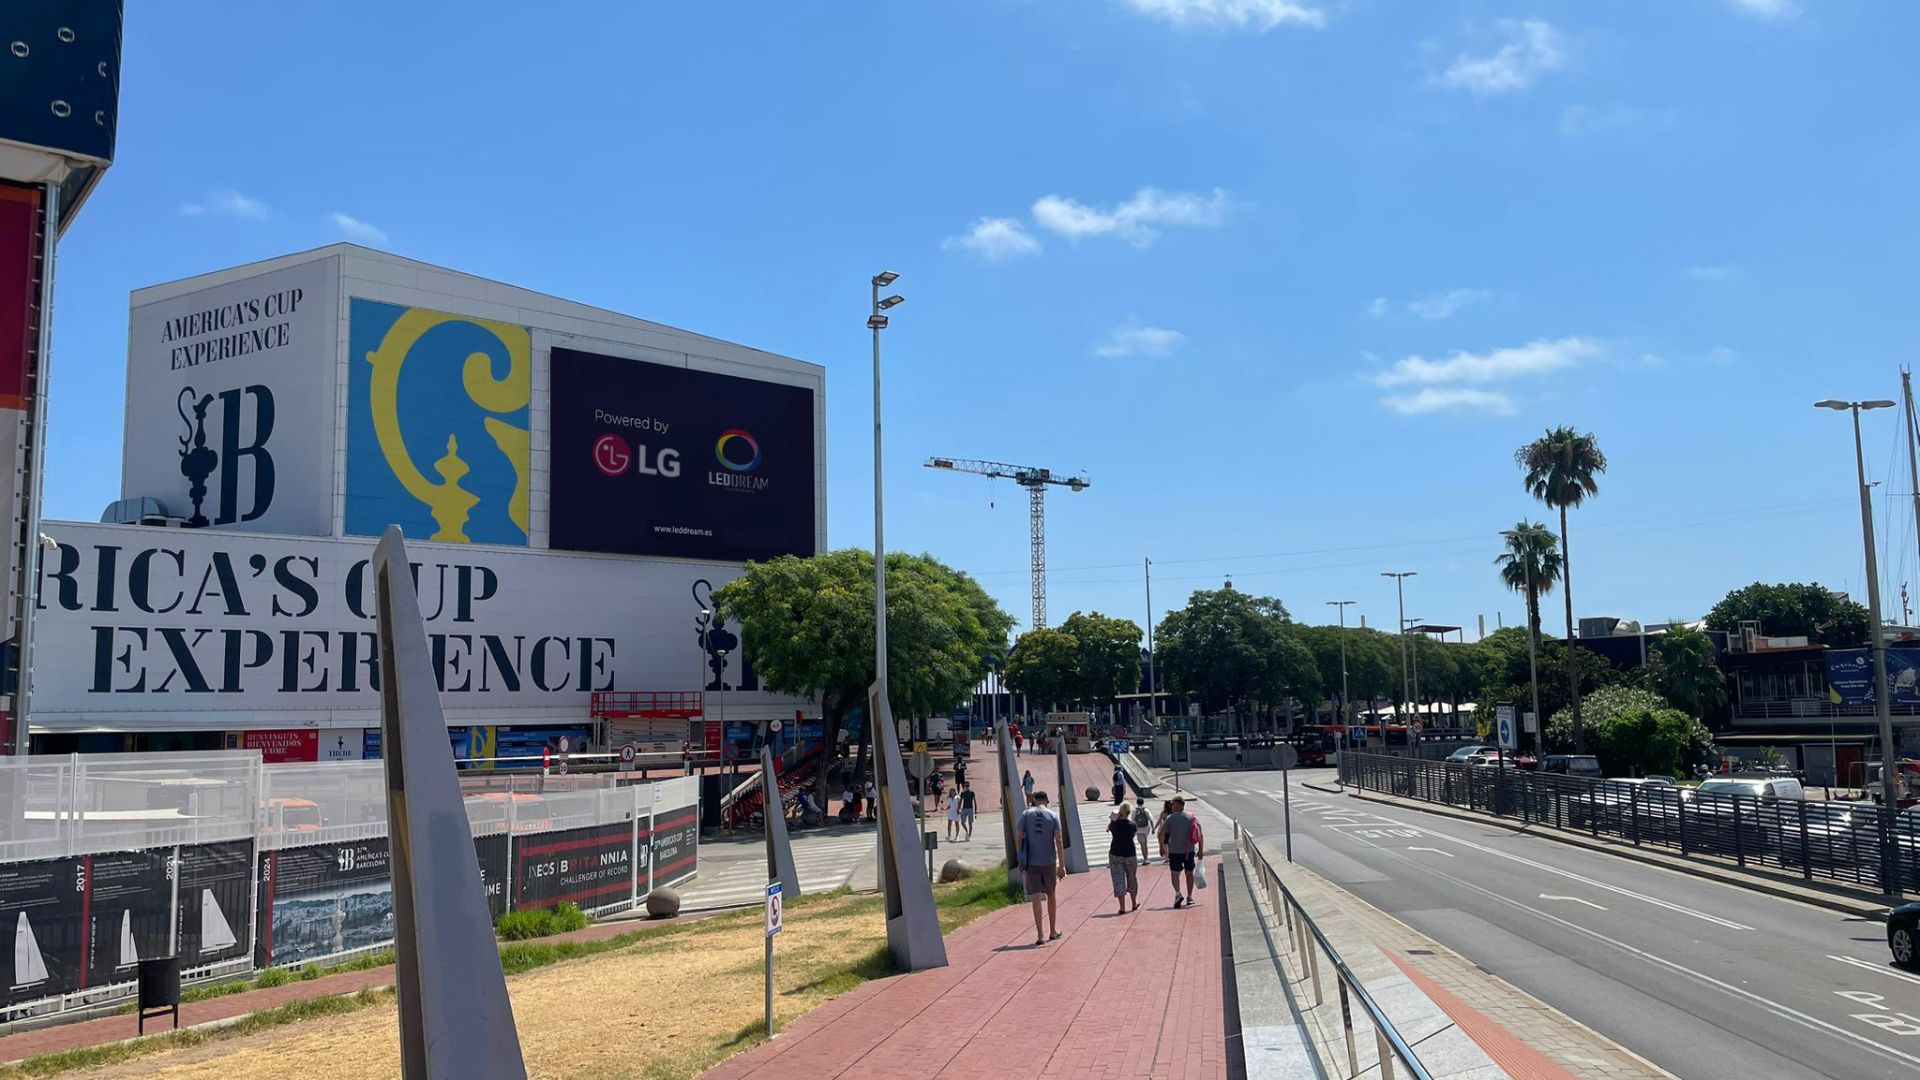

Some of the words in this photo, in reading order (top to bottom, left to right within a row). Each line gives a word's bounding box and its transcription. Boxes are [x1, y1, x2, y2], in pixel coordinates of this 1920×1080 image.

[161, 299, 260, 343] AMERICA'S
[264, 288, 303, 318] CUP
[171, 322, 290, 371] EXPERIENCE
[594, 409, 650, 430] Powered
[653, 418, 669, 434] by
[638, 444, 681, 478] LG
[708, 471, 769, 490] LEDDREAM
[653, 525, 713, 536] www.leddream.es
[88, 626, 615, 693] EXPERENCE
[1355, 829, 1424, 839] STOP
[263, 857, 271, 882] 2024
[528, 861, 555, 879] INEOS
[560, 850, 628, 873] BRITANNIA
[560, 871, 598, 886] CHALLENGER
[598, 870, 606, 879] OF
[606, 865, 628, 876] RECORD
[76, 865, 86, 892] 2017
